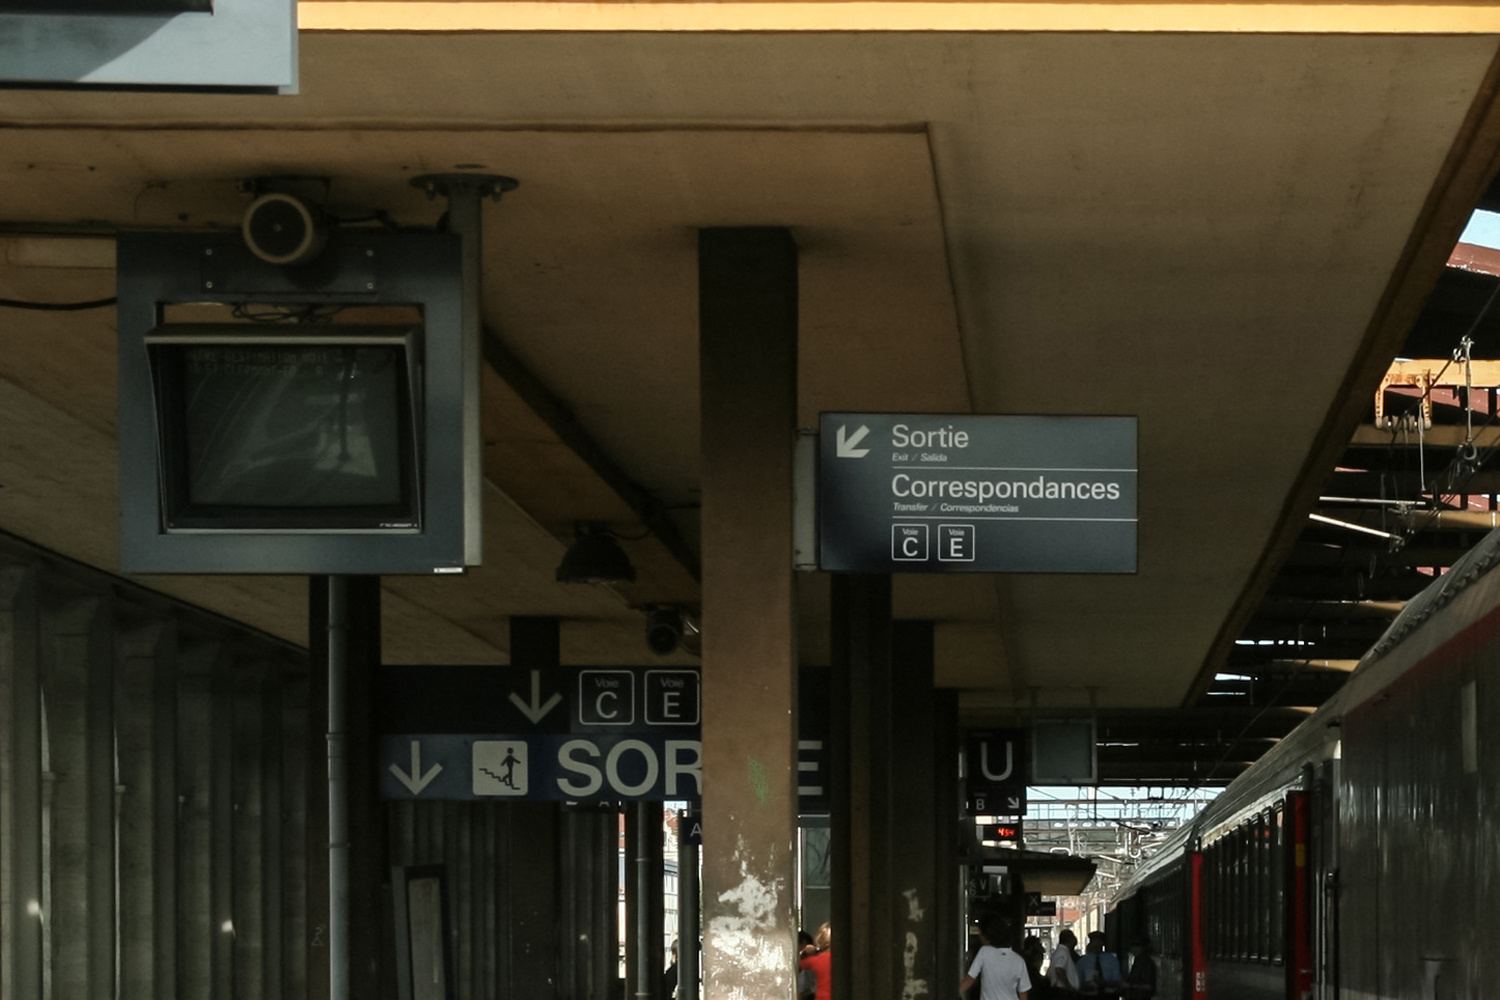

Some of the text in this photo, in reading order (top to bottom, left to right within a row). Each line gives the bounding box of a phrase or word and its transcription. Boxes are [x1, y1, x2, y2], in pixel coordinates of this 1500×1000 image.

[892, 425, 969, 448] Sortie
[892, 452, 908, 462] Exit
[920, 452, 947, 463] Salida
[892, 474, 1120, 503] Correspondances
[893, 502, 928, 512] Transfer
[940, 503, 1019, 513] Correspondencias
[902, 528, 919, 536] Voie
[948, 528, 965, 536] Voie
[902, 537, 918, 557] C
[950, 538, 963, 557] E
[595, 678, 619, 688] Voie
[660, 677, 684, 688] Voie
[596, 691, 618, 719] C
[664, 692, 680, 718] E
[556, 739, 823, 797] SORE
[981, 741, 1013, 781] U
[975, 799, 986, 811] B
